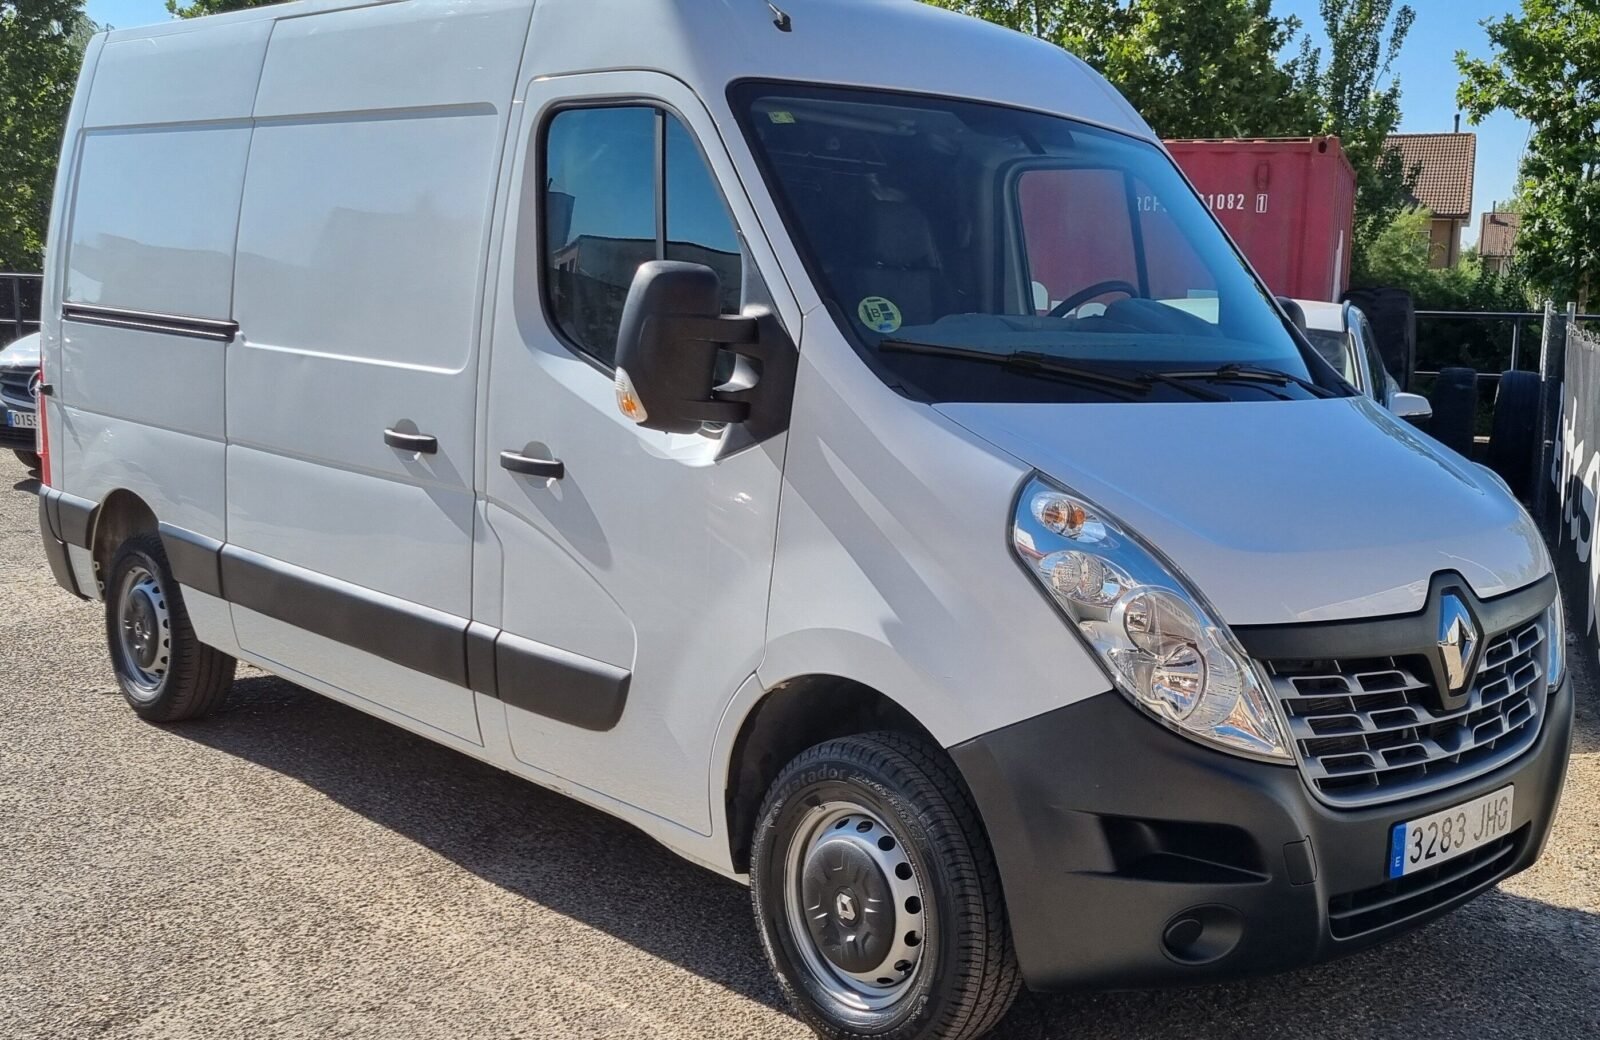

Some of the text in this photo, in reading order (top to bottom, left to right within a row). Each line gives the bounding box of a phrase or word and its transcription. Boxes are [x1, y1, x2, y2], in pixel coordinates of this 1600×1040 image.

[870, 308, 881, 318] B
[1410, 796, 1509, 864] 3283 JHG
[1394, 855, 1401, 868] E
